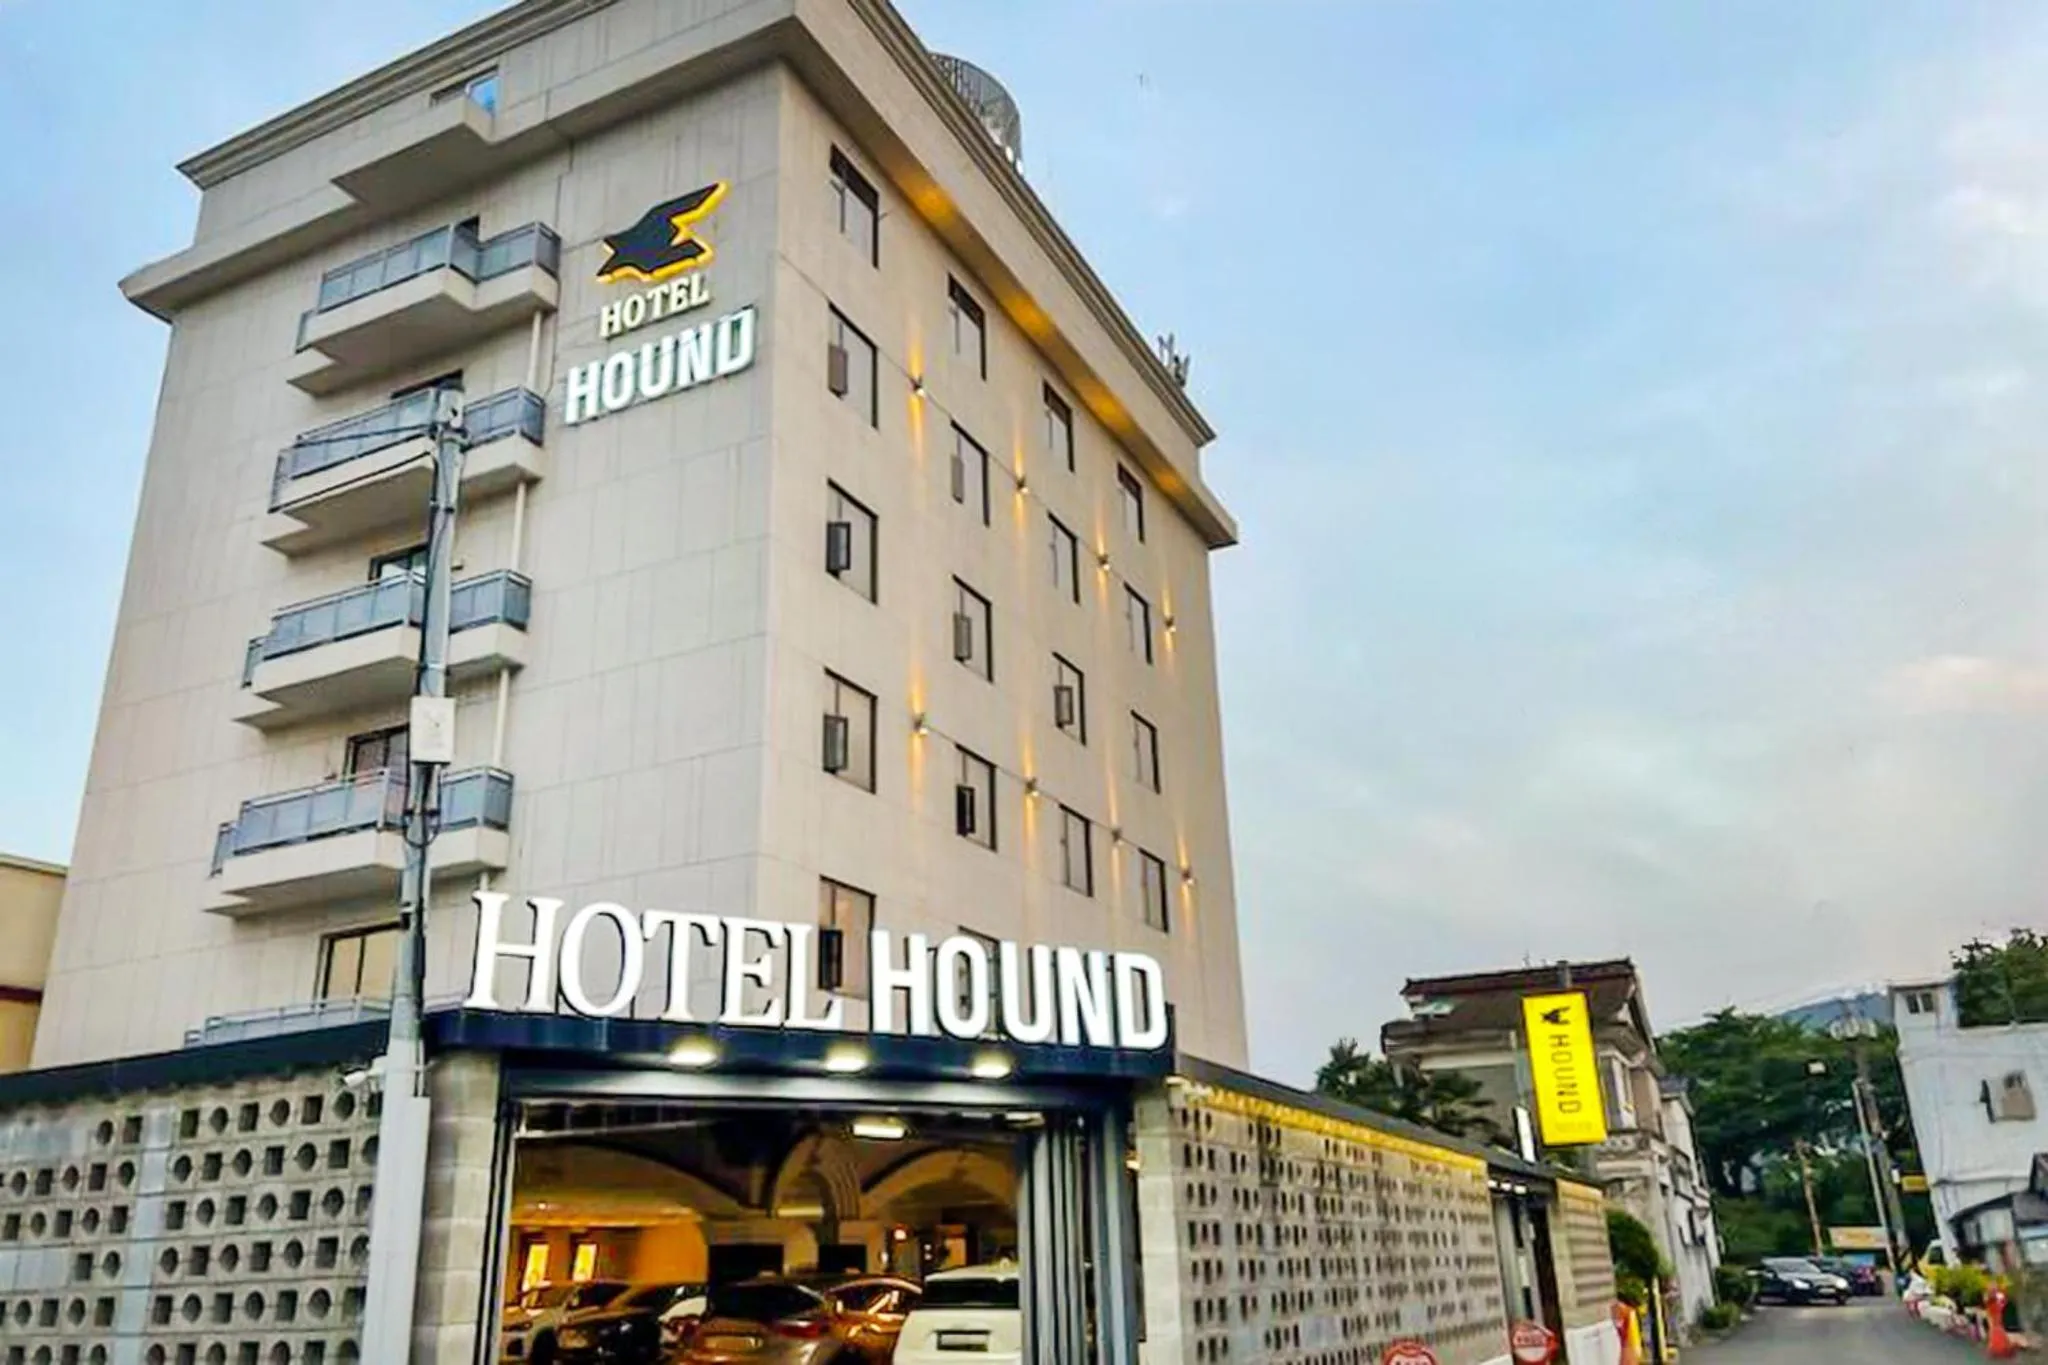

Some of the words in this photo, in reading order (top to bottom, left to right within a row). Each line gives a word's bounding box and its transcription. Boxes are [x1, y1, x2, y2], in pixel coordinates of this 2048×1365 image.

[600, 272, 711, 339] HOTEL
[565, 306, 757, 425] HOUND
[462, 889, 844, 1031] HOTEL
[870, 928, 1168, 1050] HOUND
[1549, 1033, 1582, 1114] HOUND
